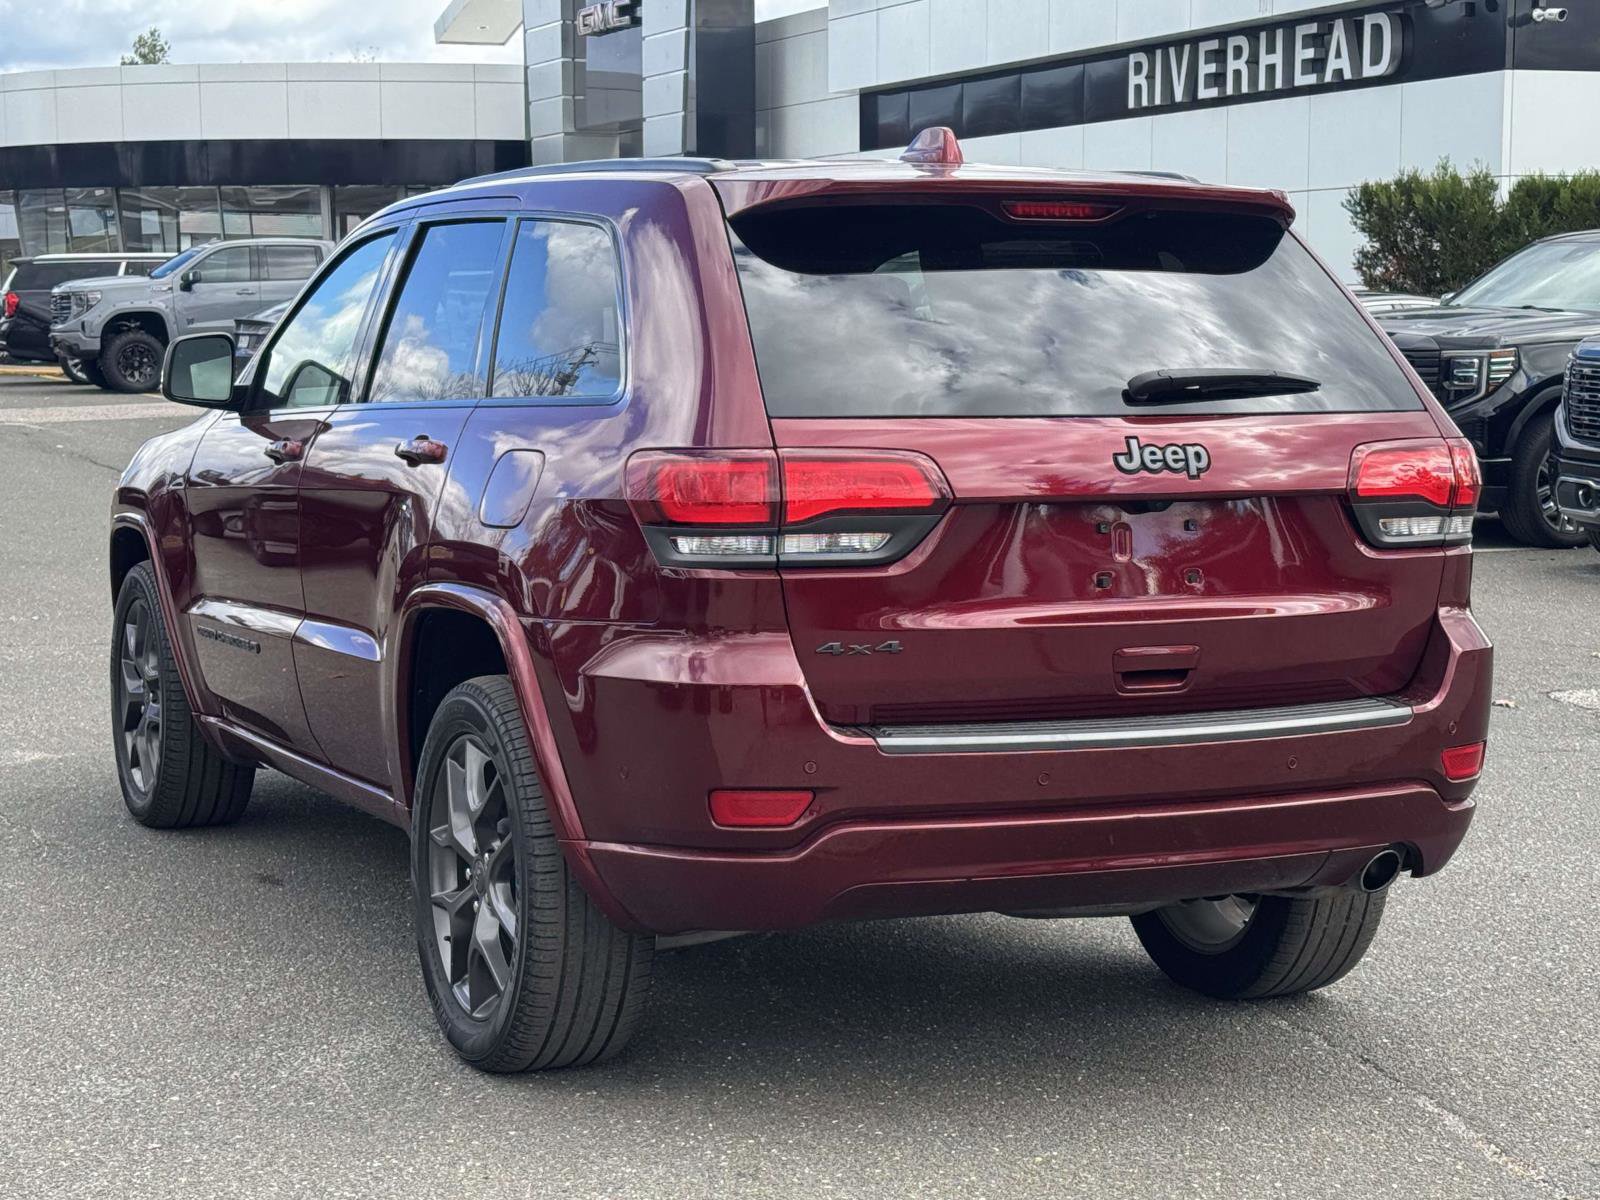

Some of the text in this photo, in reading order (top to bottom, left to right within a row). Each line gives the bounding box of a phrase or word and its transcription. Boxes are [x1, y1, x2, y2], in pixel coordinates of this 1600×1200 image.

[577, 0, 631, 35] GMC
[1127, 12, 1397, 109] RIVERHEAD
[1114, 437, 1210, 479] Jeep
[815, 640, 904, 656] 4x4
